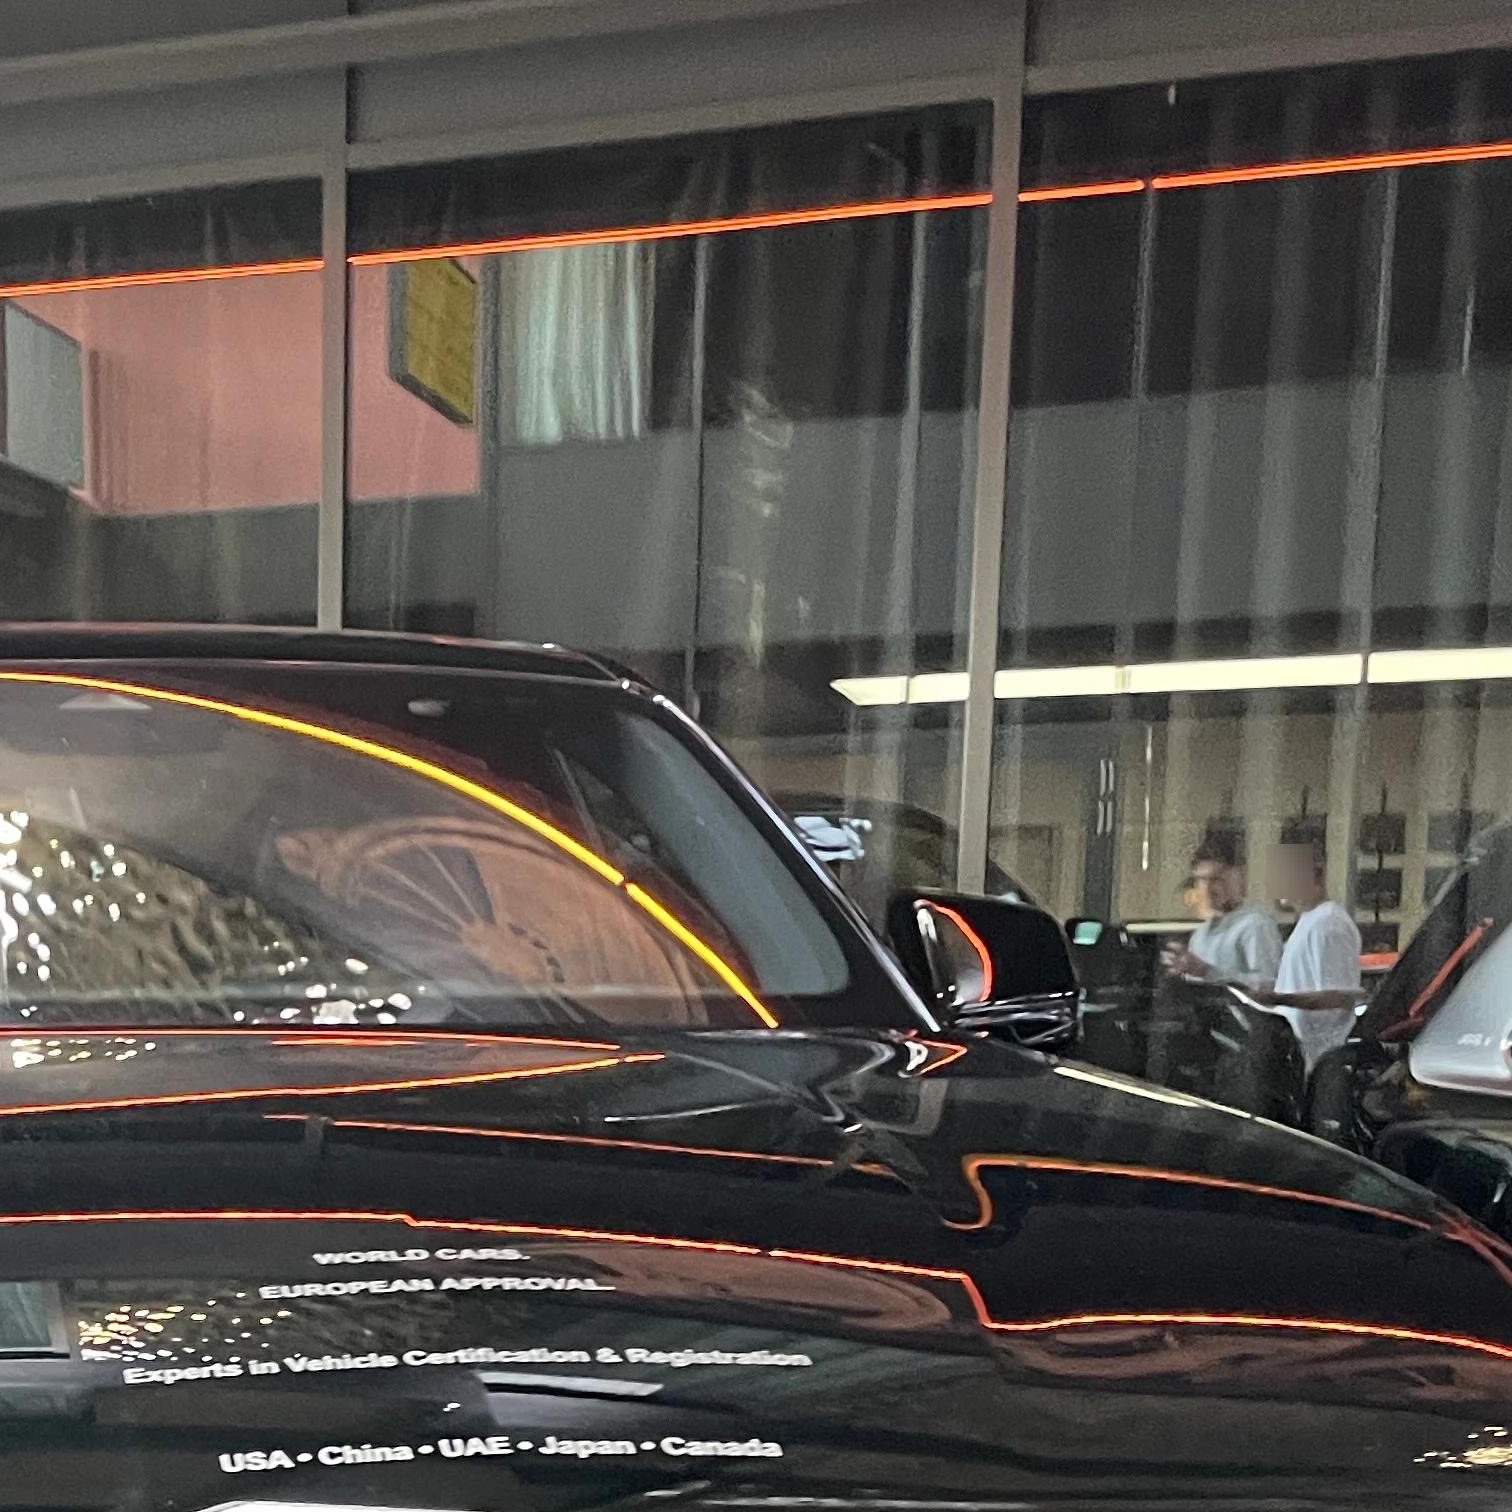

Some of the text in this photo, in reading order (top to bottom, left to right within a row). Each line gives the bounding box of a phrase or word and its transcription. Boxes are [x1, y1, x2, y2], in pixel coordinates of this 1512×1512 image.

[311, 1248, 531, 1265] WORLD CARS.
[258, 1278, 436, 1299] EUROPEAN
[122, 1347, 813, 1385] Experts in Vehicle Certification & Registration
[218, 1435, 784, 1473] USA China UAE Japan Canada
